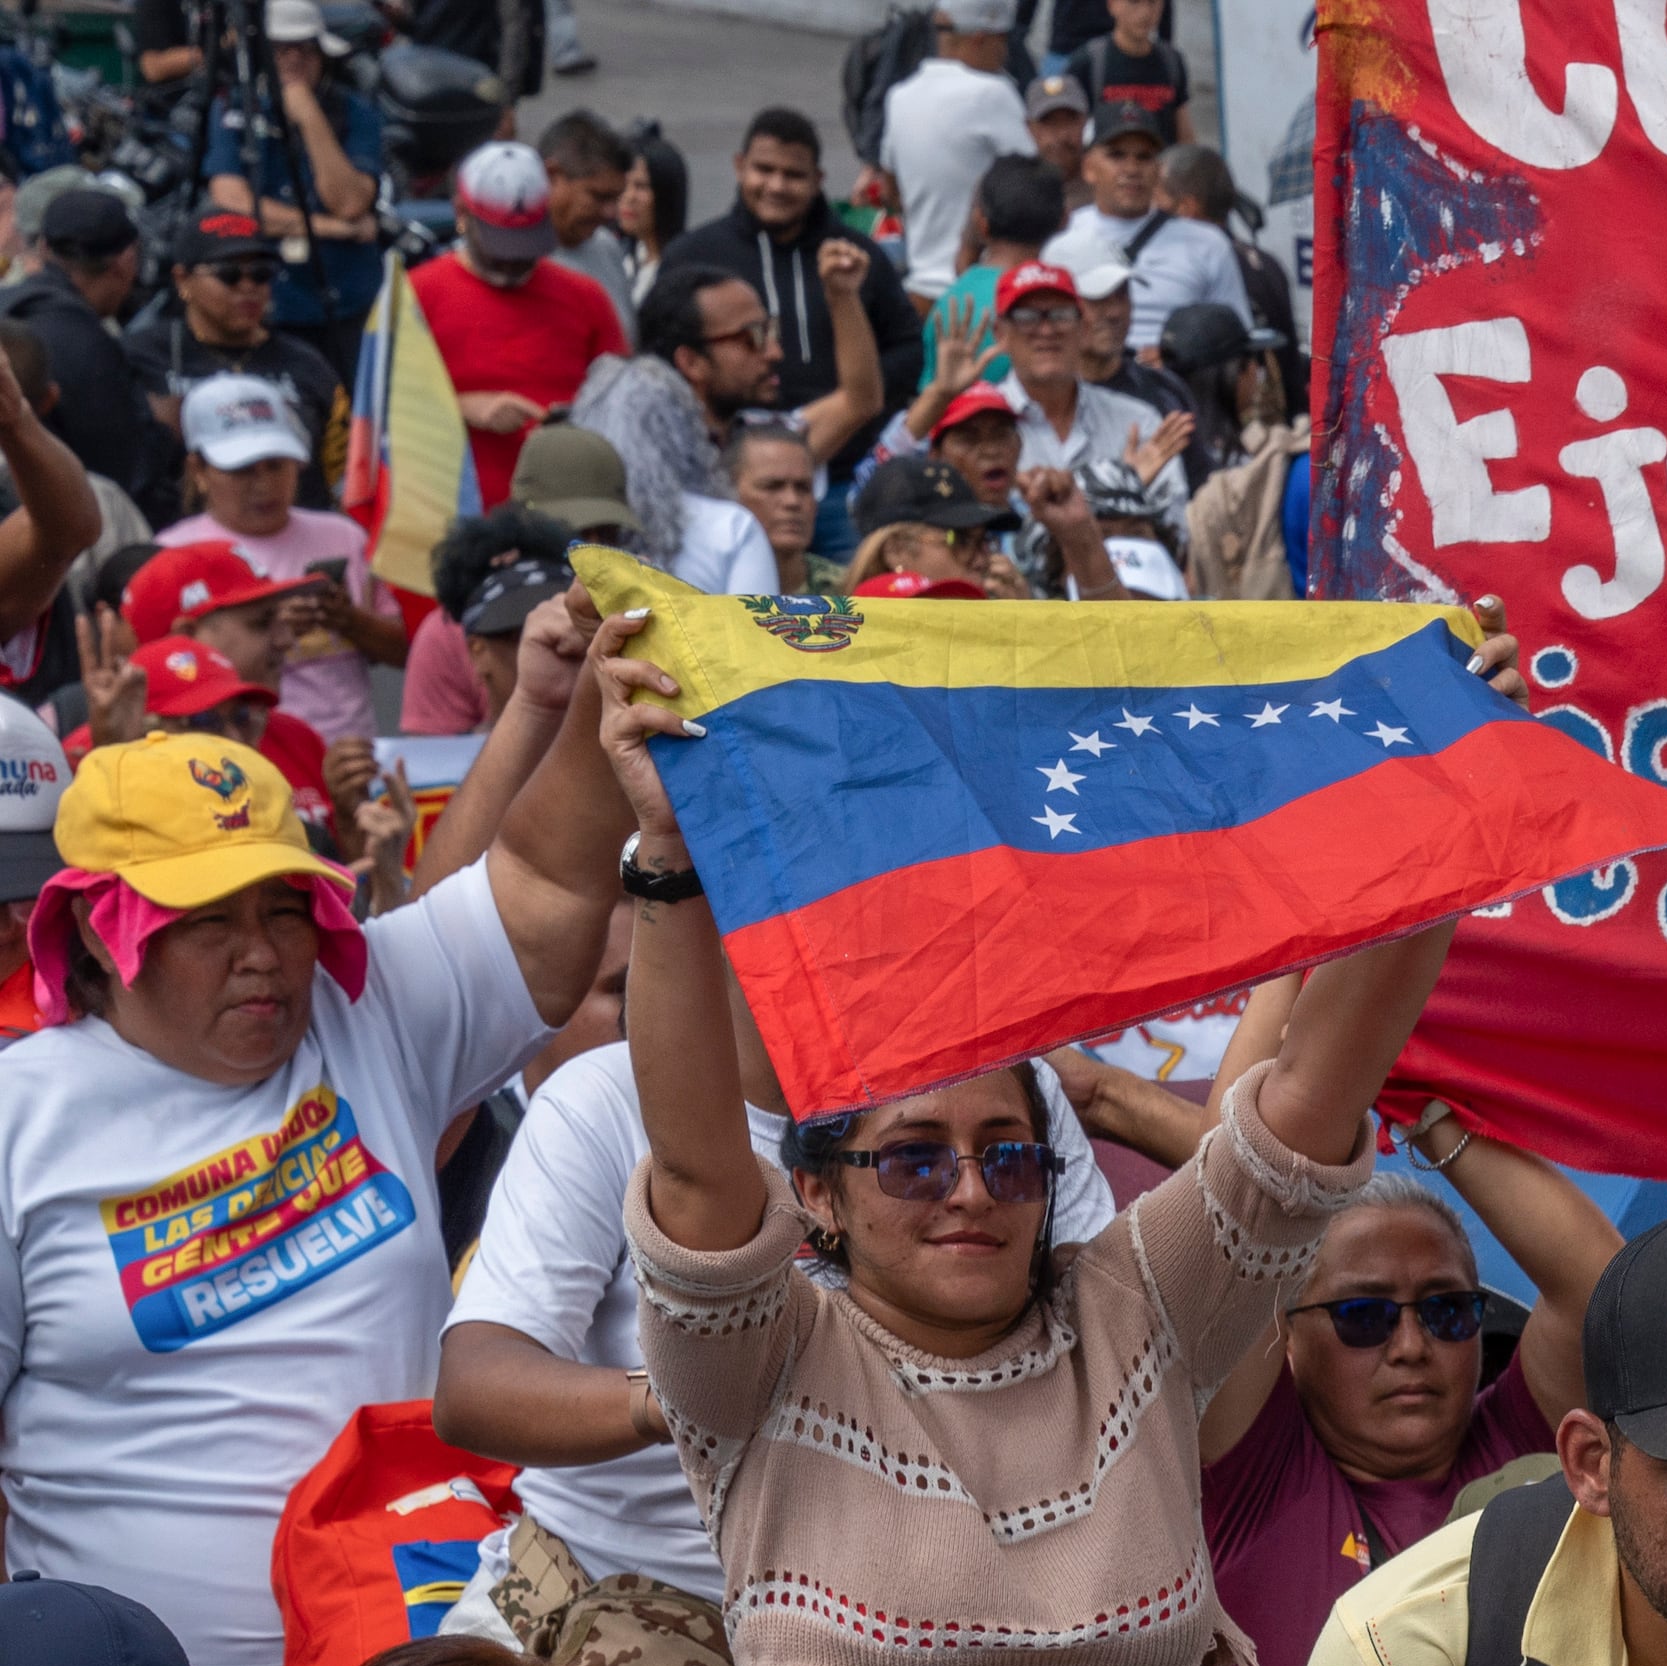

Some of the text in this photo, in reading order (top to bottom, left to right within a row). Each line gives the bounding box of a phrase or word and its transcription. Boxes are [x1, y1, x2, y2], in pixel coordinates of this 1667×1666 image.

[114, 1147, 258, 1229] COMUNA
[144, 1205, 213, 1253] LAS
[180, 1186, 397, 1327] RESUELVE
